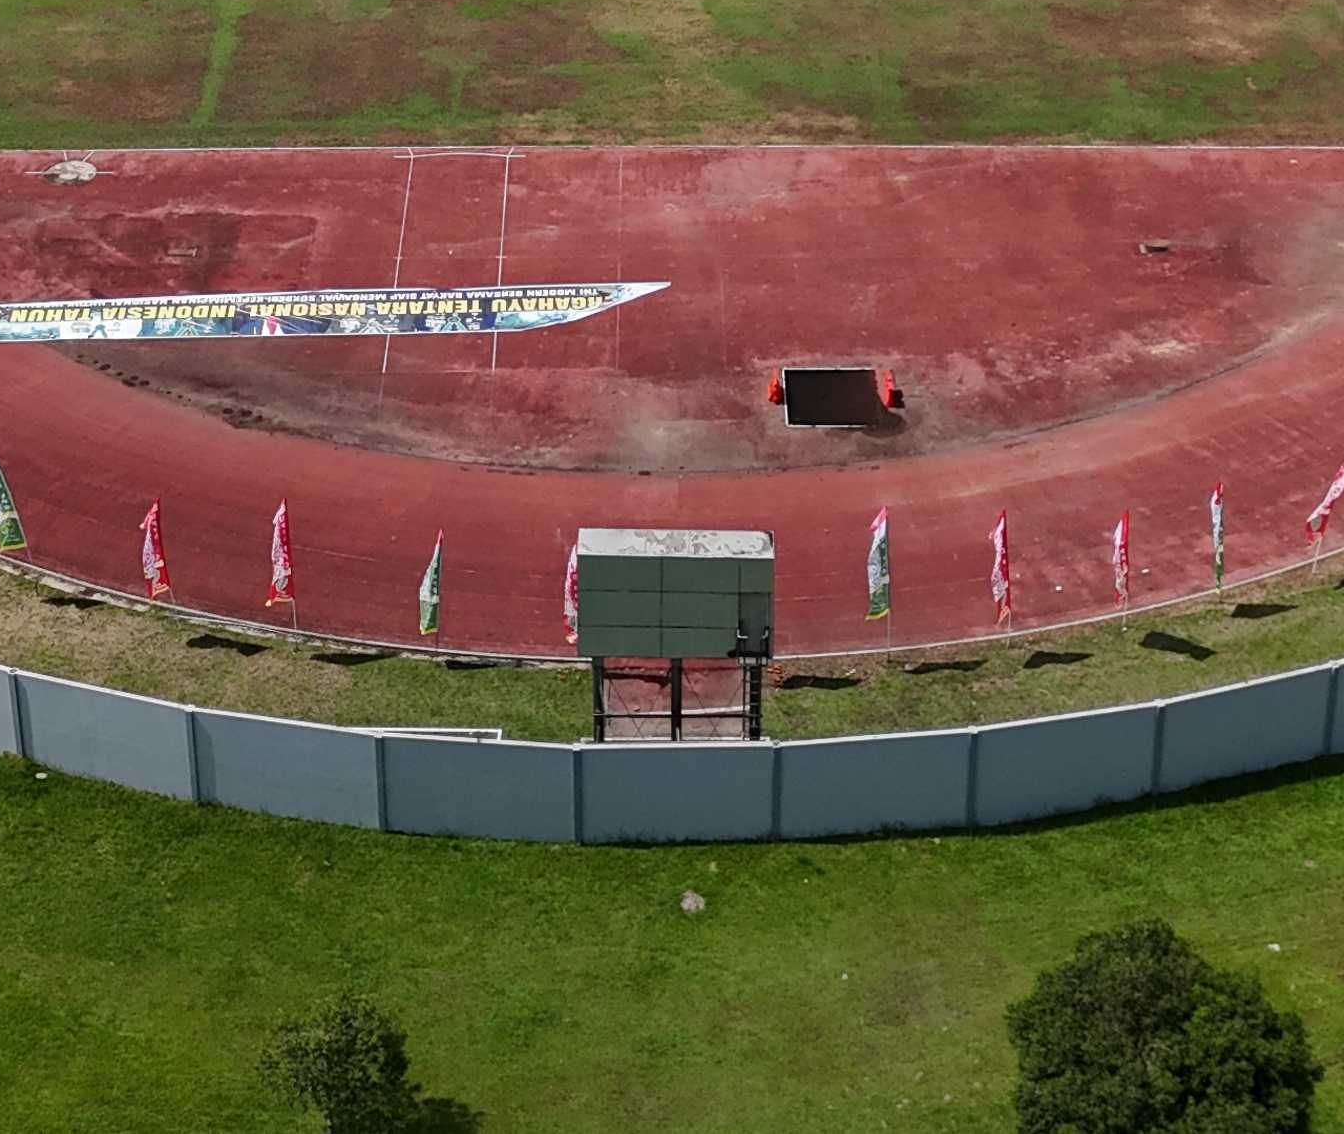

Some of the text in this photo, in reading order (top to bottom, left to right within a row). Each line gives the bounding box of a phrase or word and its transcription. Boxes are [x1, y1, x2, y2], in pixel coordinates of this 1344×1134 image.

[10, 307, 91, 323] TAHUN
[103, 304, 236, 320] INDONESIA
[250, 301, 366, 316] NASIONAL
[377, 300, 482, 315] TENTARA
